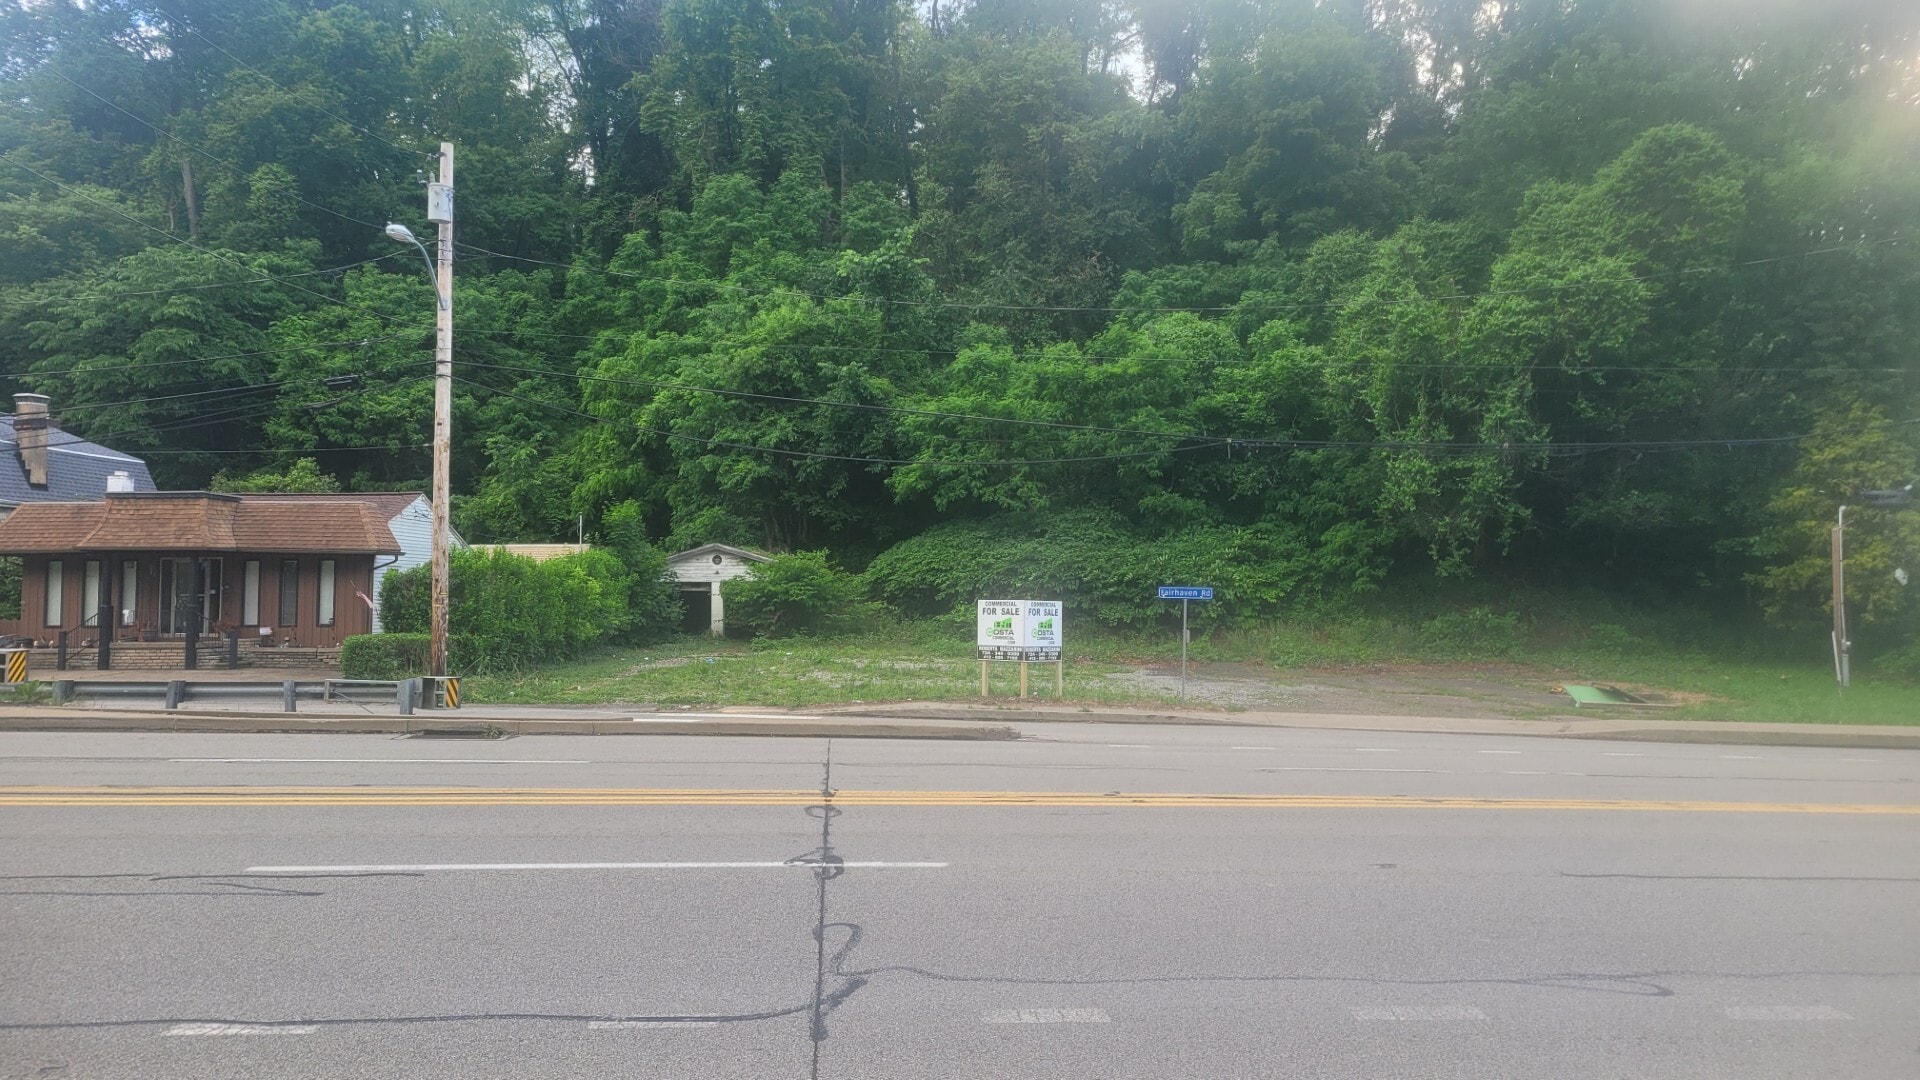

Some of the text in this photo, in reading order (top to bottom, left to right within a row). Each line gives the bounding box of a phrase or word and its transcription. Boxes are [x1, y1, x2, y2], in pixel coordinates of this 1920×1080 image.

[982, 607, 1020, 616] FOR SALE
[1028, 608, 1059, 617] FOR SALE
